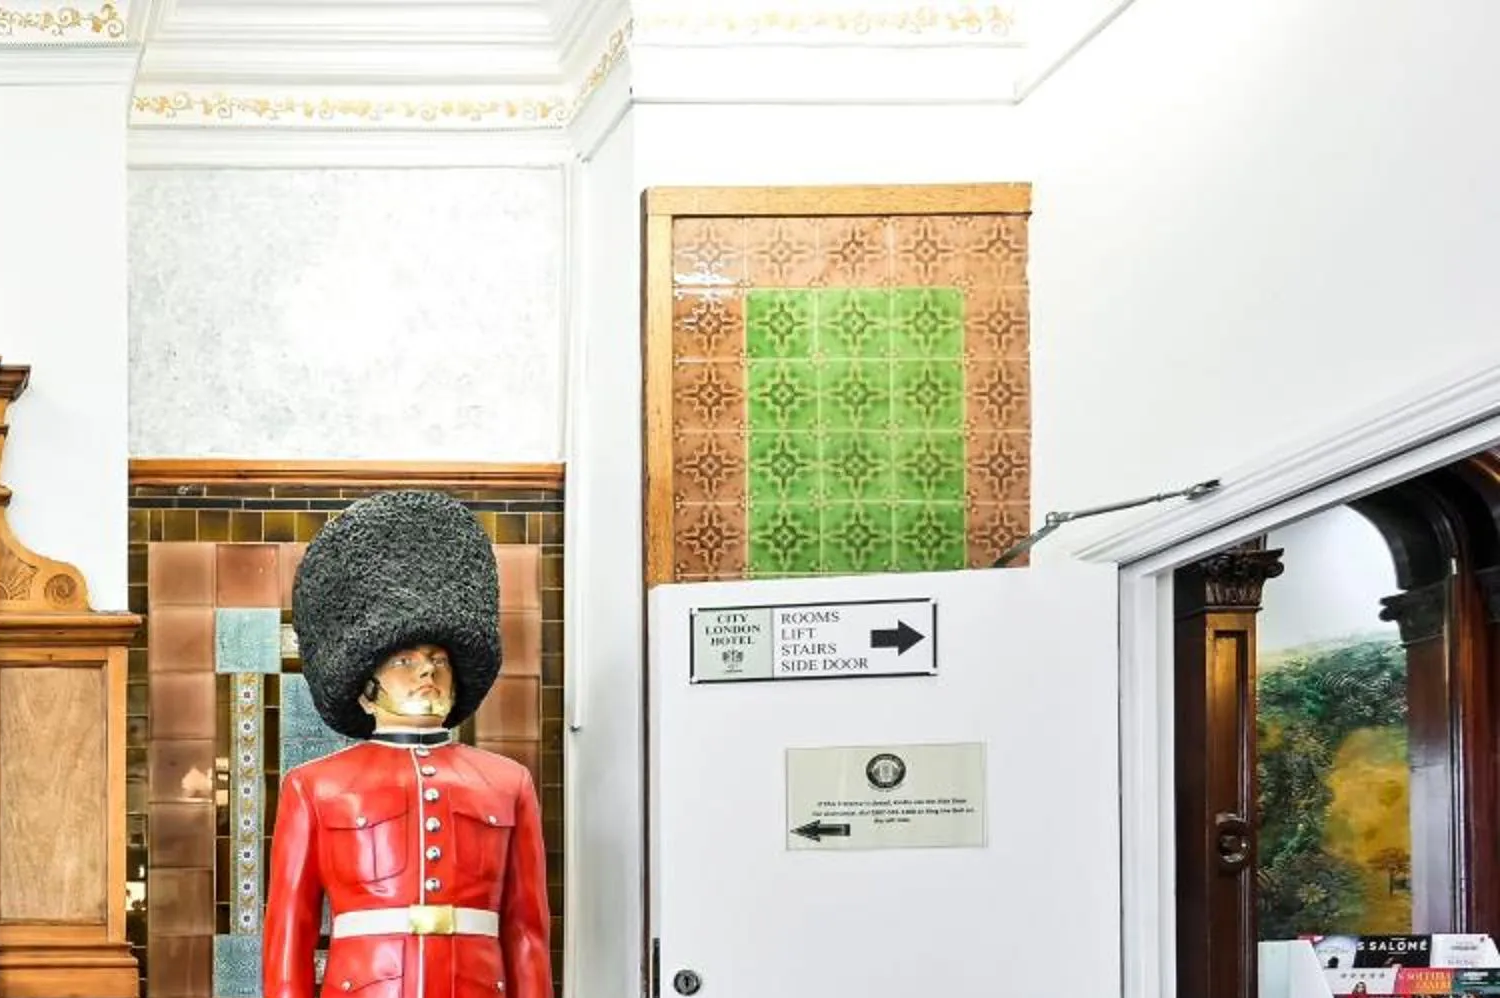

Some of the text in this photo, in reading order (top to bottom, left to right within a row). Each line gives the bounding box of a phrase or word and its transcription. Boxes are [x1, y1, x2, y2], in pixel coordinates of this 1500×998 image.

[717, 613, 749, 624] CITY
[781, 610, 841, 625] ROOMS
[705, 624, 761, 636] LONDON
[781, 627, 817, 640] LIFT
[710, 635, 756, 646] HOTEL
[781, 643, 837, 656] STAIRS
[781, 657, 869, 672] SIDE DOOR
